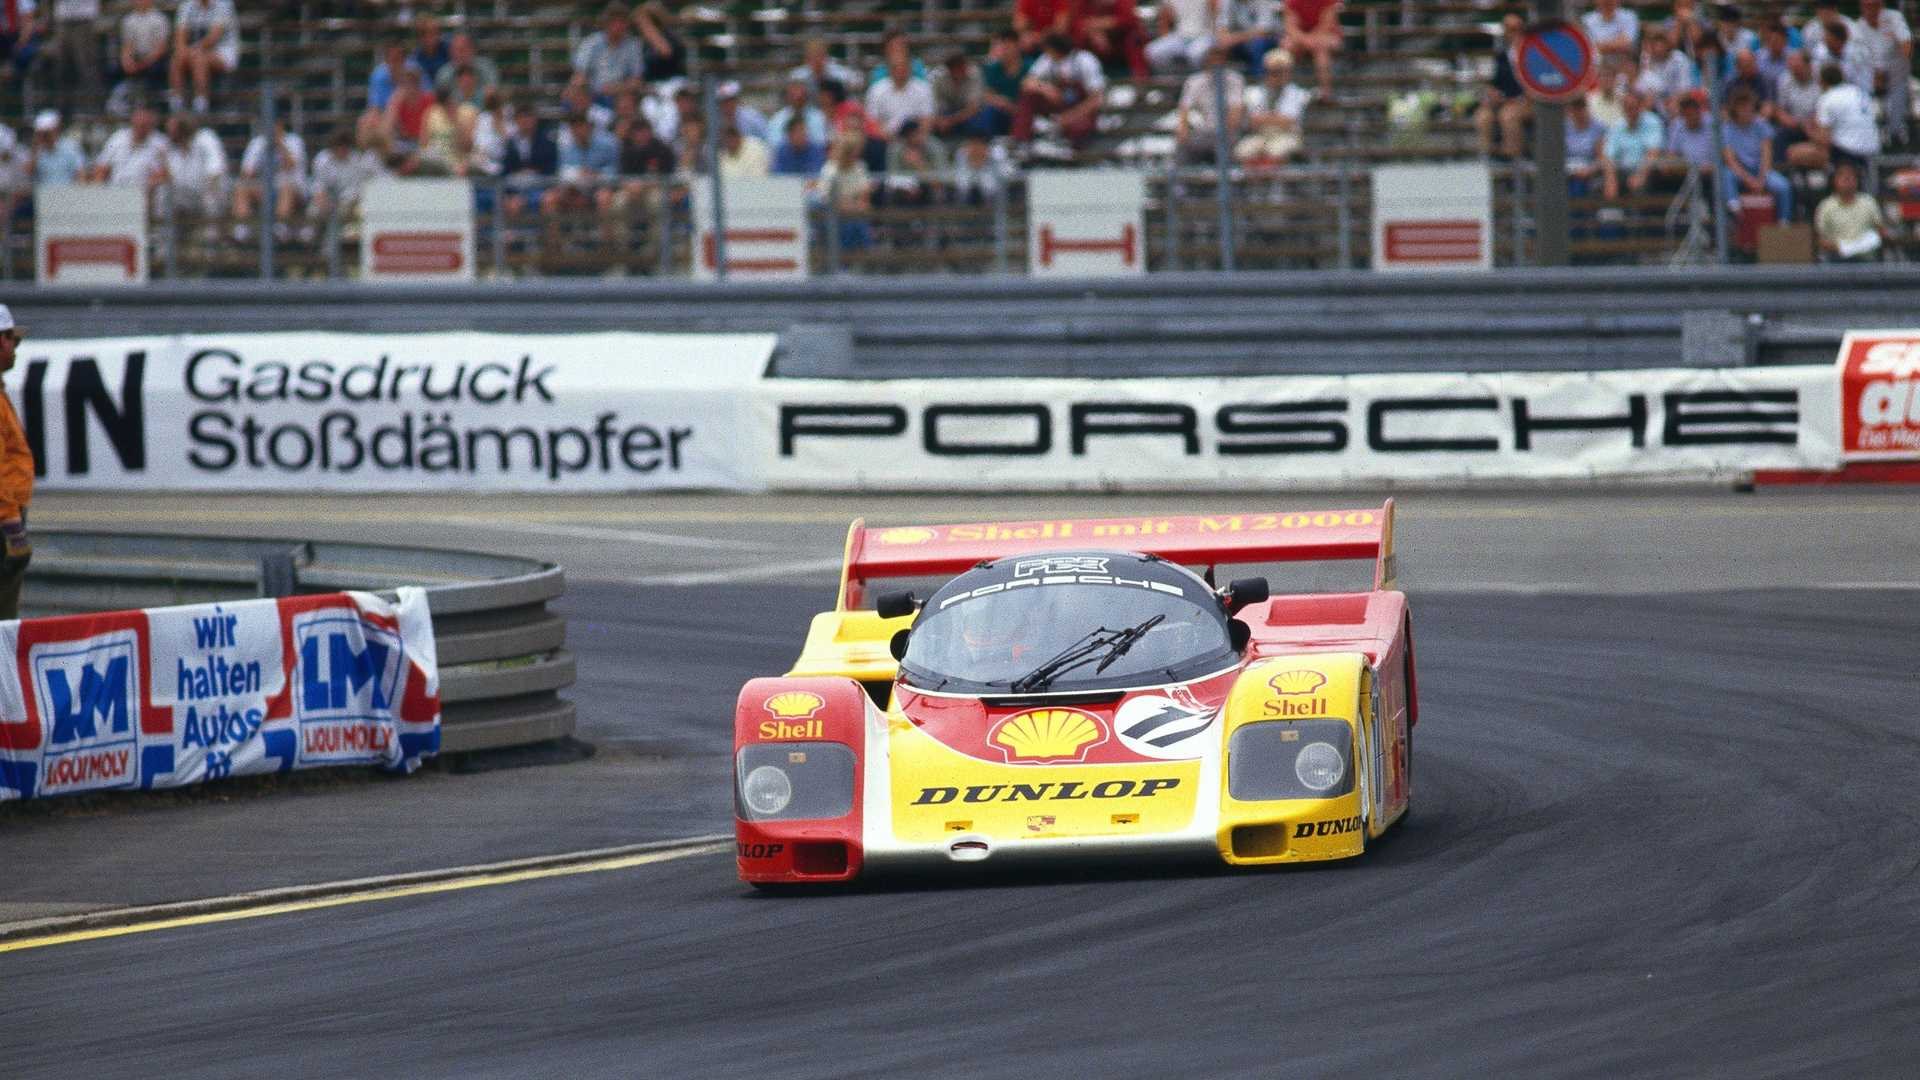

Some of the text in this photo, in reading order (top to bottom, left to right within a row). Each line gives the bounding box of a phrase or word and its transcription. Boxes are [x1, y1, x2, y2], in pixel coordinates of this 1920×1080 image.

[184, 347, 557, 403] Gasdruck
[779, 389, 1799, 457] PORSCHE
[187, 410, 695, 482] Stoßdämpfer
[948, 512, 1374, 542] Shell mit M2000
[939, 575, 1184, 610] PORSCHE
[193, 605, 238, 650] wir
[177, 655, 261, 701] halten
[1263, 698, 1327, 716] Shell
[182, 704, 264, 749] Autos
[304, 724, 394, 753] LIQUI MOLY
[758, 720, 824, 740] Shell
[88, 749, 129, 780] MOLY
[910, 778, 1182, 806] DUNLOP
[1292, 815, 1362, 838] DUNLO
